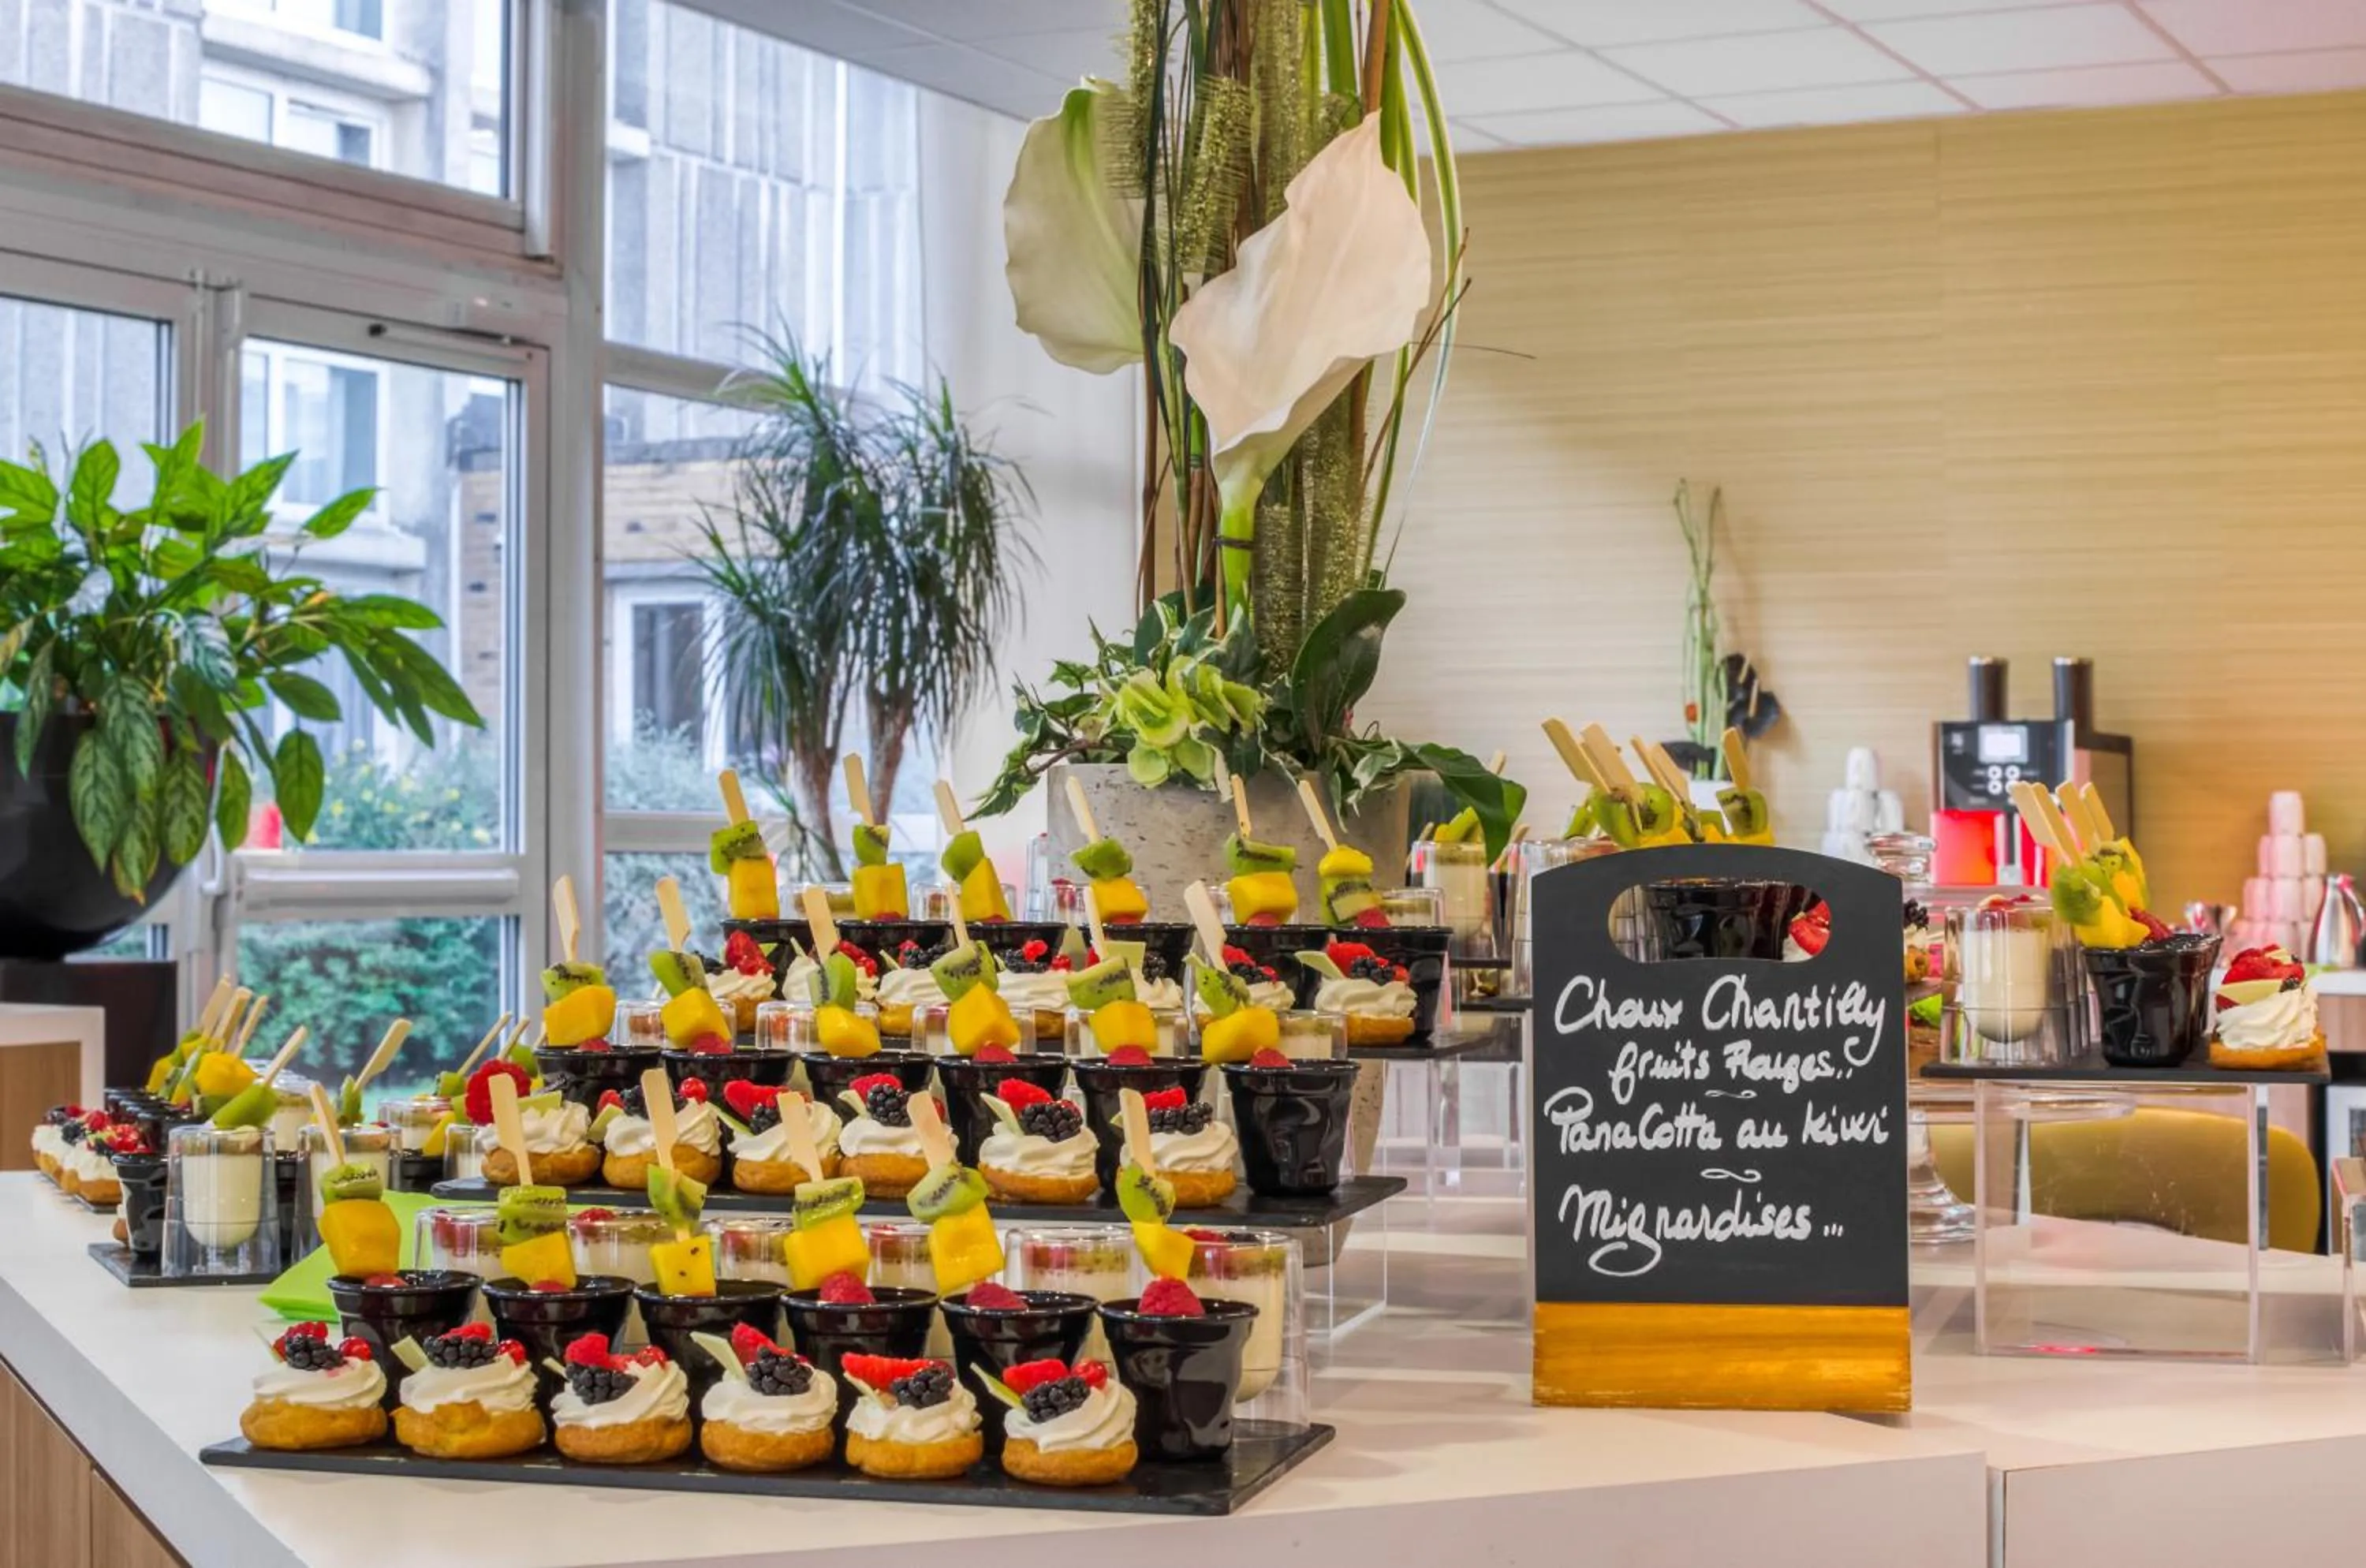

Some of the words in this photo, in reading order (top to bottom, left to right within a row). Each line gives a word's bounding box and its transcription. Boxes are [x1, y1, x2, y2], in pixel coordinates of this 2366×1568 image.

[1554, 976, 1683, 1034] Choux
[1701, 973, 1886, 1066] Chantilly
[1607, 1039, 1710, 1105] fruits
[1736, 1118, 1789, 1149] au
[1801, 1100, 1890, 1145] kiwi
